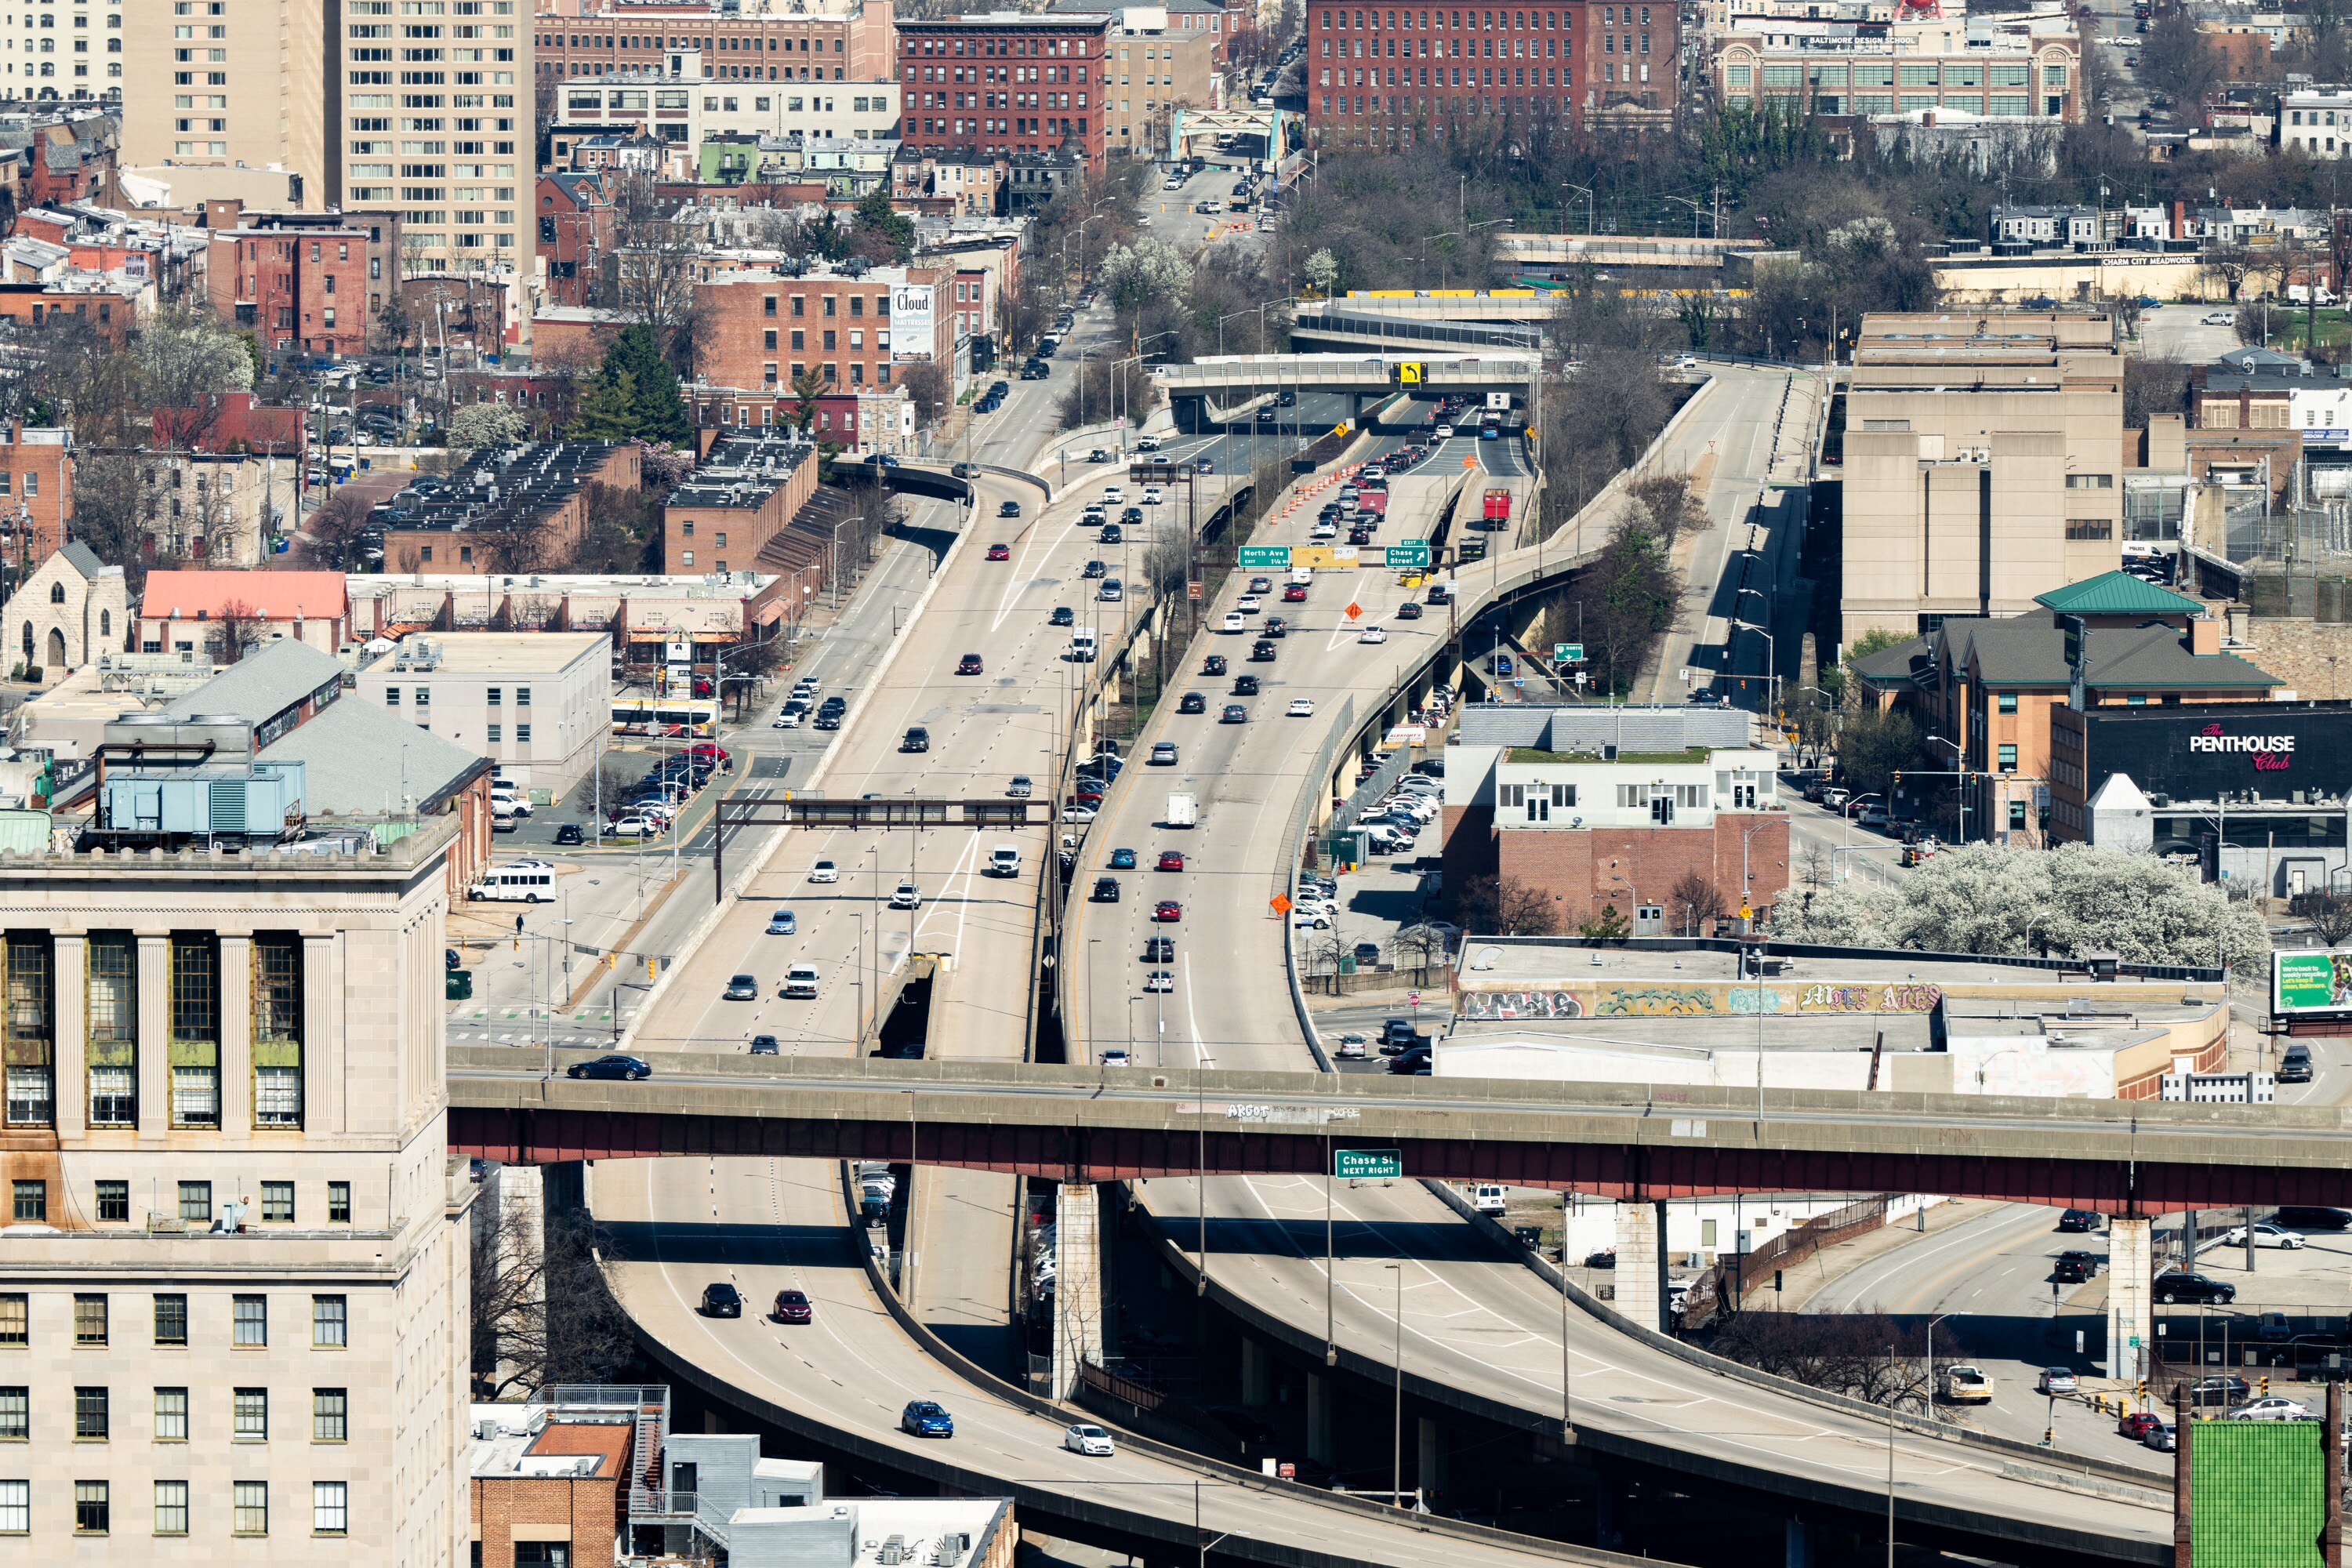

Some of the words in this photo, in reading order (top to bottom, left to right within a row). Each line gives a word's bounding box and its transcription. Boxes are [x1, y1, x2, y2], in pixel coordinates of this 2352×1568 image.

[2150, 256, 2195, 265] MEADWORKS
[898, 294, 929, 310] Cloud
[2201, 723, 2223, 735] The
[2190, 735, 2295, 752] PENTHOUSE
[2252, 750, 2290, 771] Club
[1227, 1104, 1270, 1118] ARGOT
[1343, 1156, 1376, 1165] Chase
[1381, 1155, 1394, 1164] St
